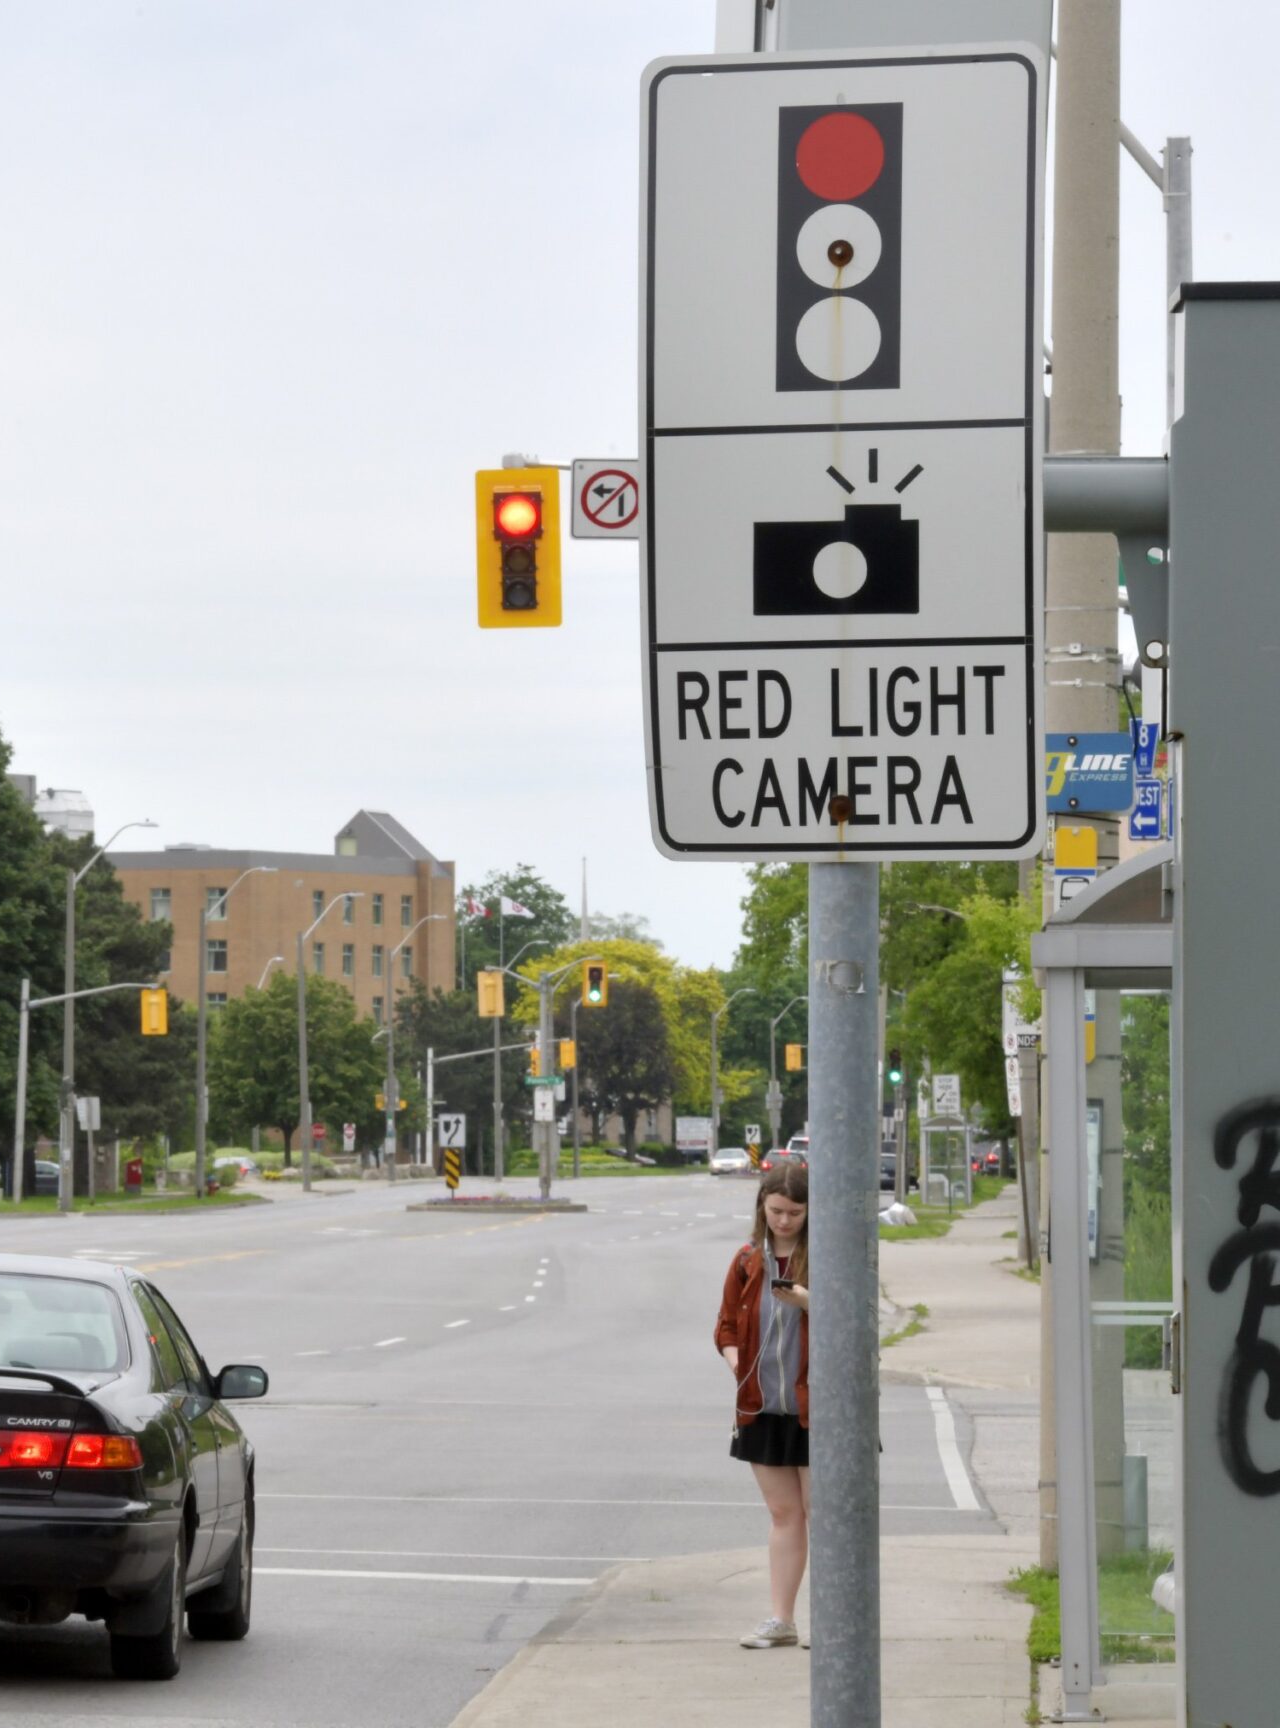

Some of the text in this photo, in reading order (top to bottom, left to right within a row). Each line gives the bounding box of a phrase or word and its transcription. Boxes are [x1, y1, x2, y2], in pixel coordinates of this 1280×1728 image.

[677, 665, 1005, 740] RED LIGHT
[712, 755, 974, 828] CAMERA
[1017, 1035, 1037, 1047] NDS
[6, 1417, 56, 1426] CAMRY
[37, 1470, 53, 1480] V6
